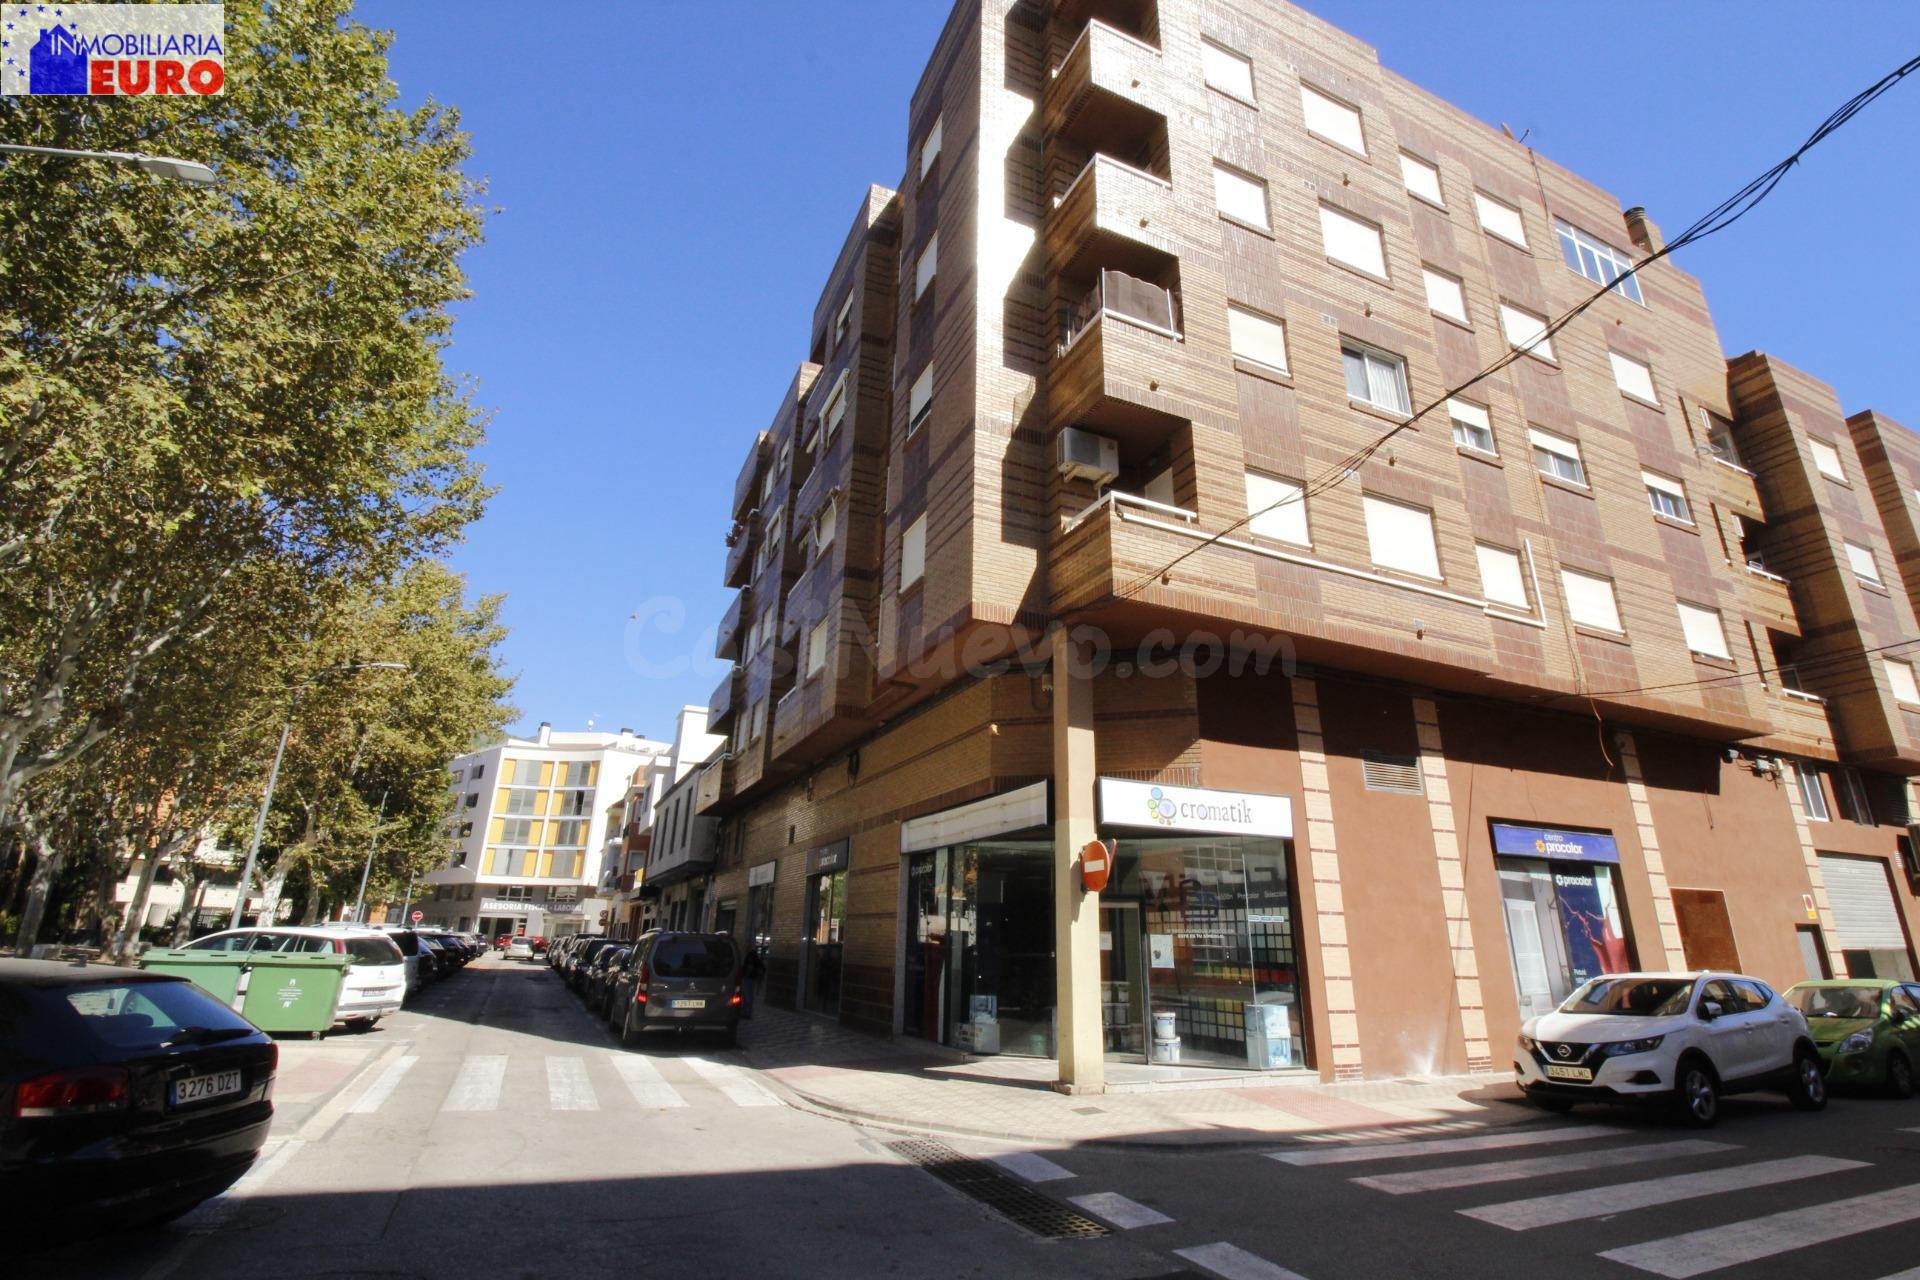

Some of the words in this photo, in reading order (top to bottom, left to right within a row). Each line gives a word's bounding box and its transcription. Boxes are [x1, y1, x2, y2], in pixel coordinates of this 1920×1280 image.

[1180, 799, 1252, 823] cromatik
[1544, 833, 1563, 842] centro
[1545, 842, 1583, 854] procolor
[1563, 874, 1593, 887] procolor
[482, 902, 522, 911] ASESORIA
[178, 1077, 214, 1100] 3276
[217, 1071, 239, 1092] DZT
